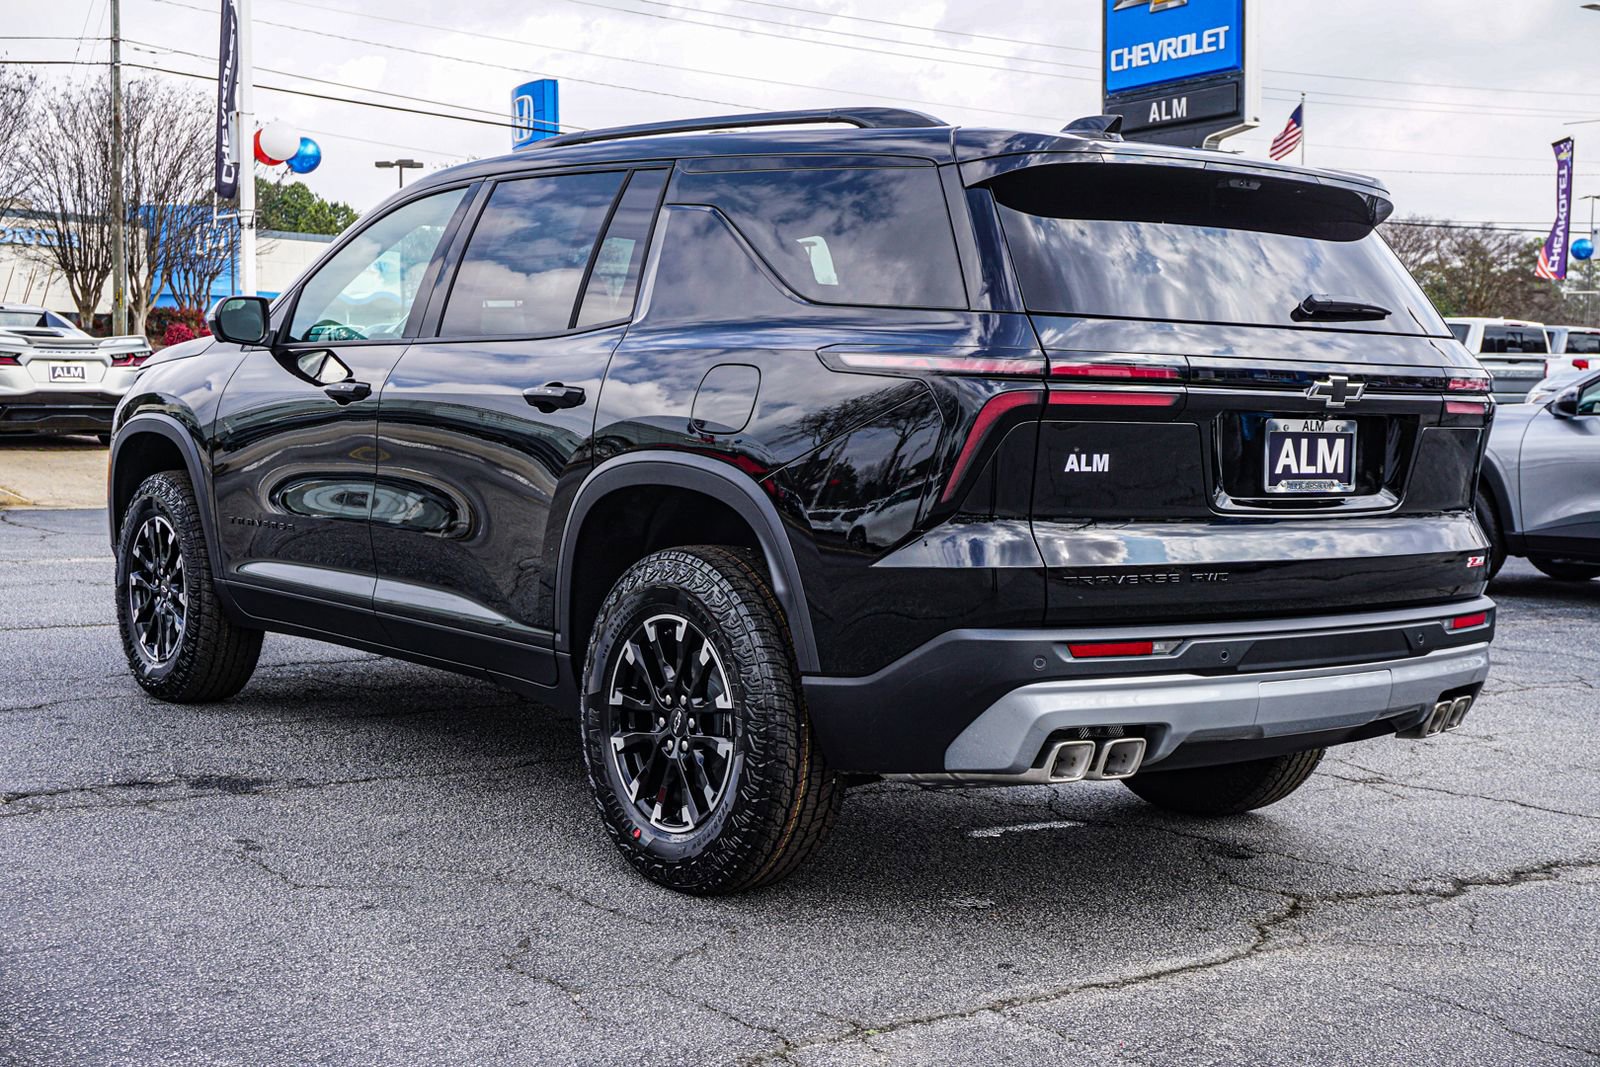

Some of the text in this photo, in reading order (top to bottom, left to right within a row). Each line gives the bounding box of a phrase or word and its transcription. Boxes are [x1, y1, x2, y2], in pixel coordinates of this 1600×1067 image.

[1111, 25, 1229, 71] CHEVROLET
[1148, 97, 1187, 123] ALM
[54, 367, 83, 378] ALM
[1302, 420, 1325, 432] ALM
[1064, 453, 1110, 472] ALM
[1274, 438, 1345, 474] ALM
[1063, 573, 1181, 585] TRAVERSE
